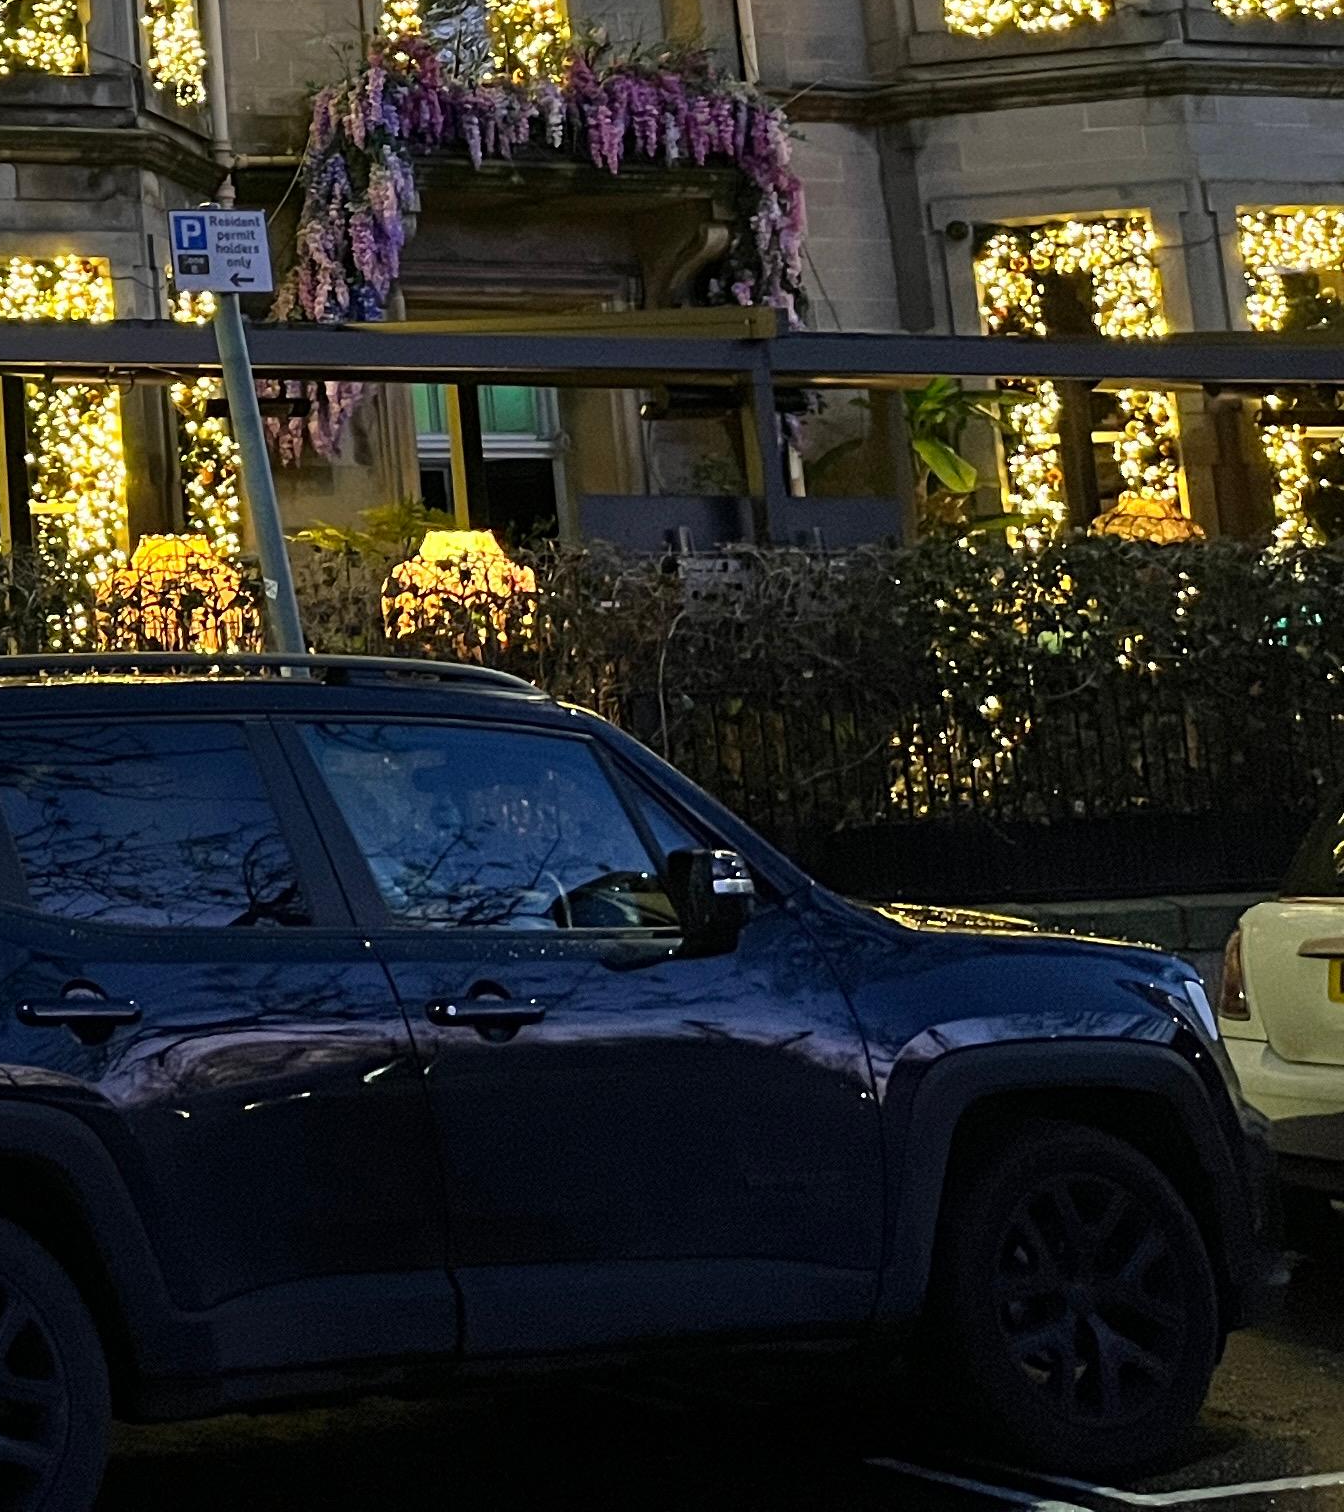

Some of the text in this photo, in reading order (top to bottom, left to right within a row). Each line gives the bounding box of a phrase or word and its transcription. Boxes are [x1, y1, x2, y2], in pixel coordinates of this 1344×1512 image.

[209, 216, 261, 227] Resident
[217, 231, 256, 240] permit
[215, 243, 260, 254] holders
[226, 256, 252, 269] only
